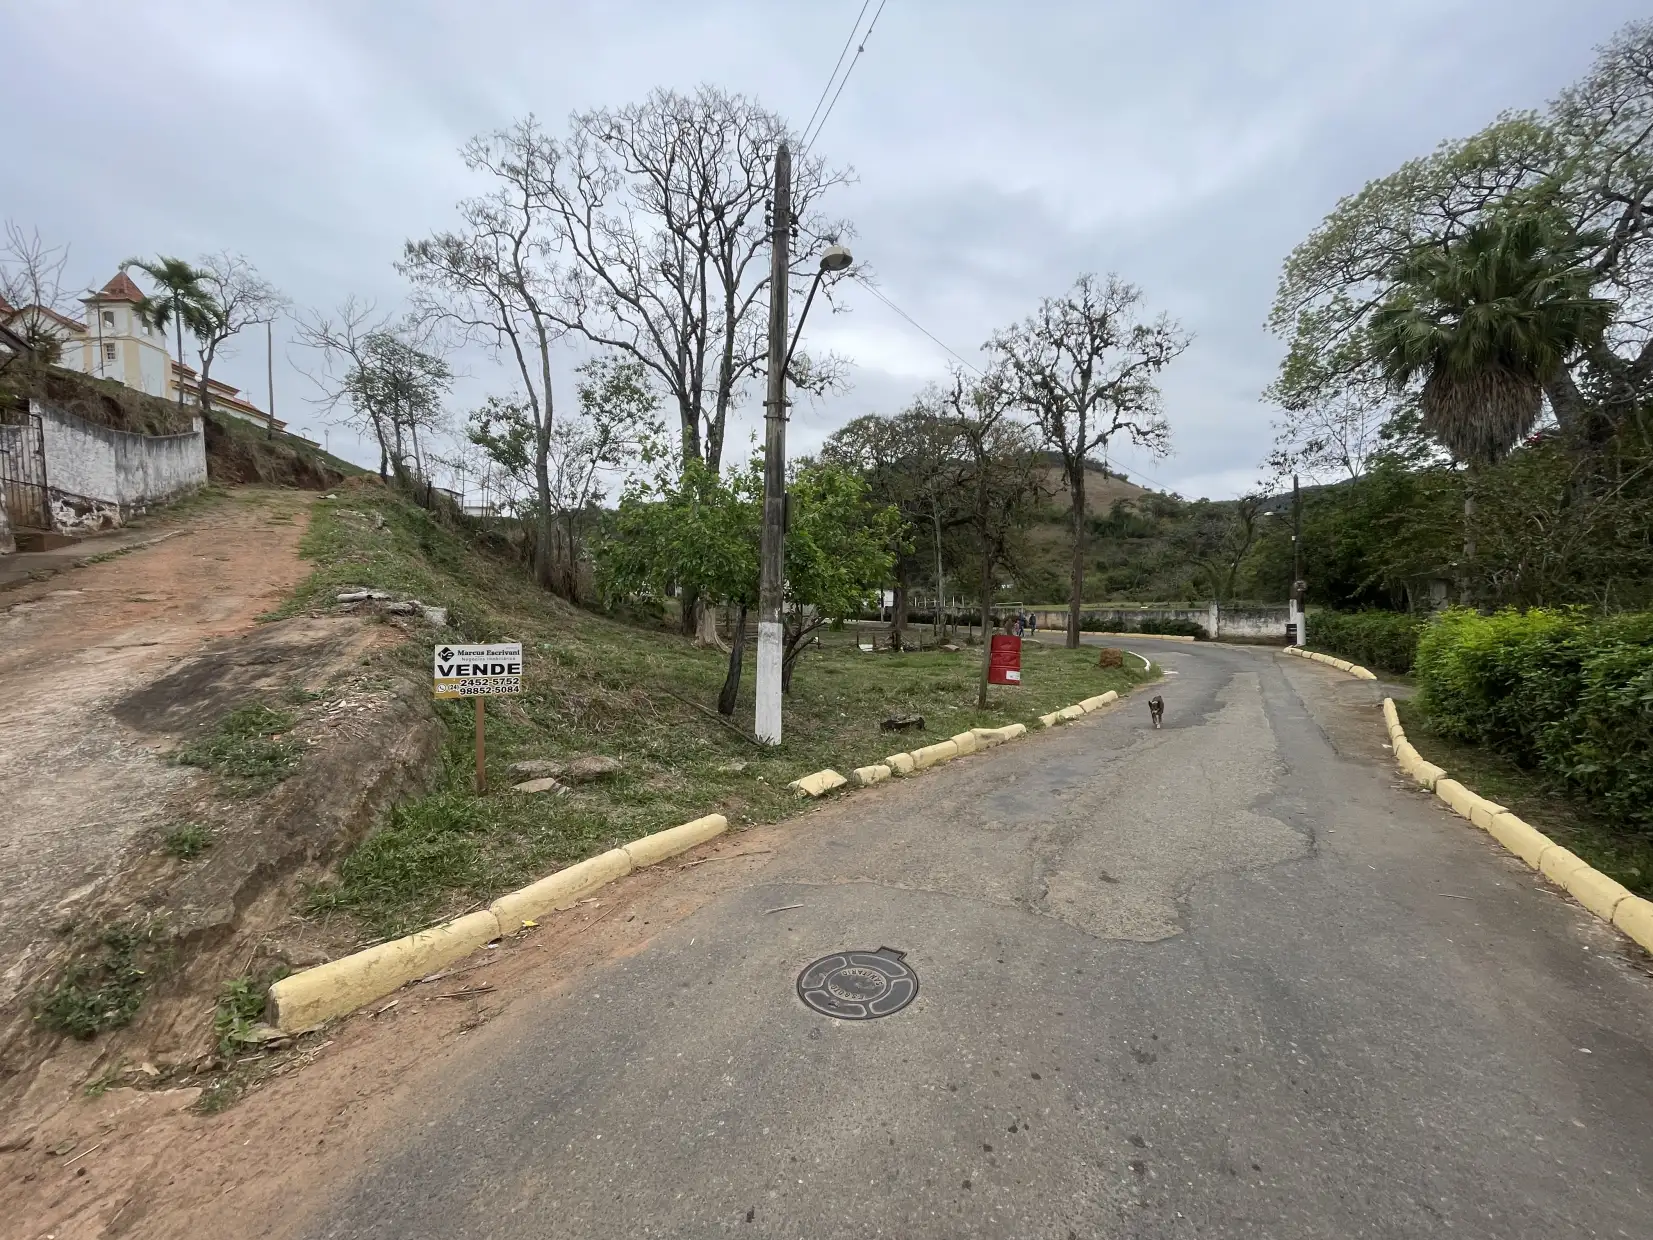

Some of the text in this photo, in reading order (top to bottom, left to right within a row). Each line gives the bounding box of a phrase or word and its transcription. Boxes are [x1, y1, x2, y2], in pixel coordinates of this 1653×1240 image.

[437, 663, 521, 677] VENDE
[460, 678, 520, 687] 2452-5752
[460, 686, 520, 694] 98852-5084
